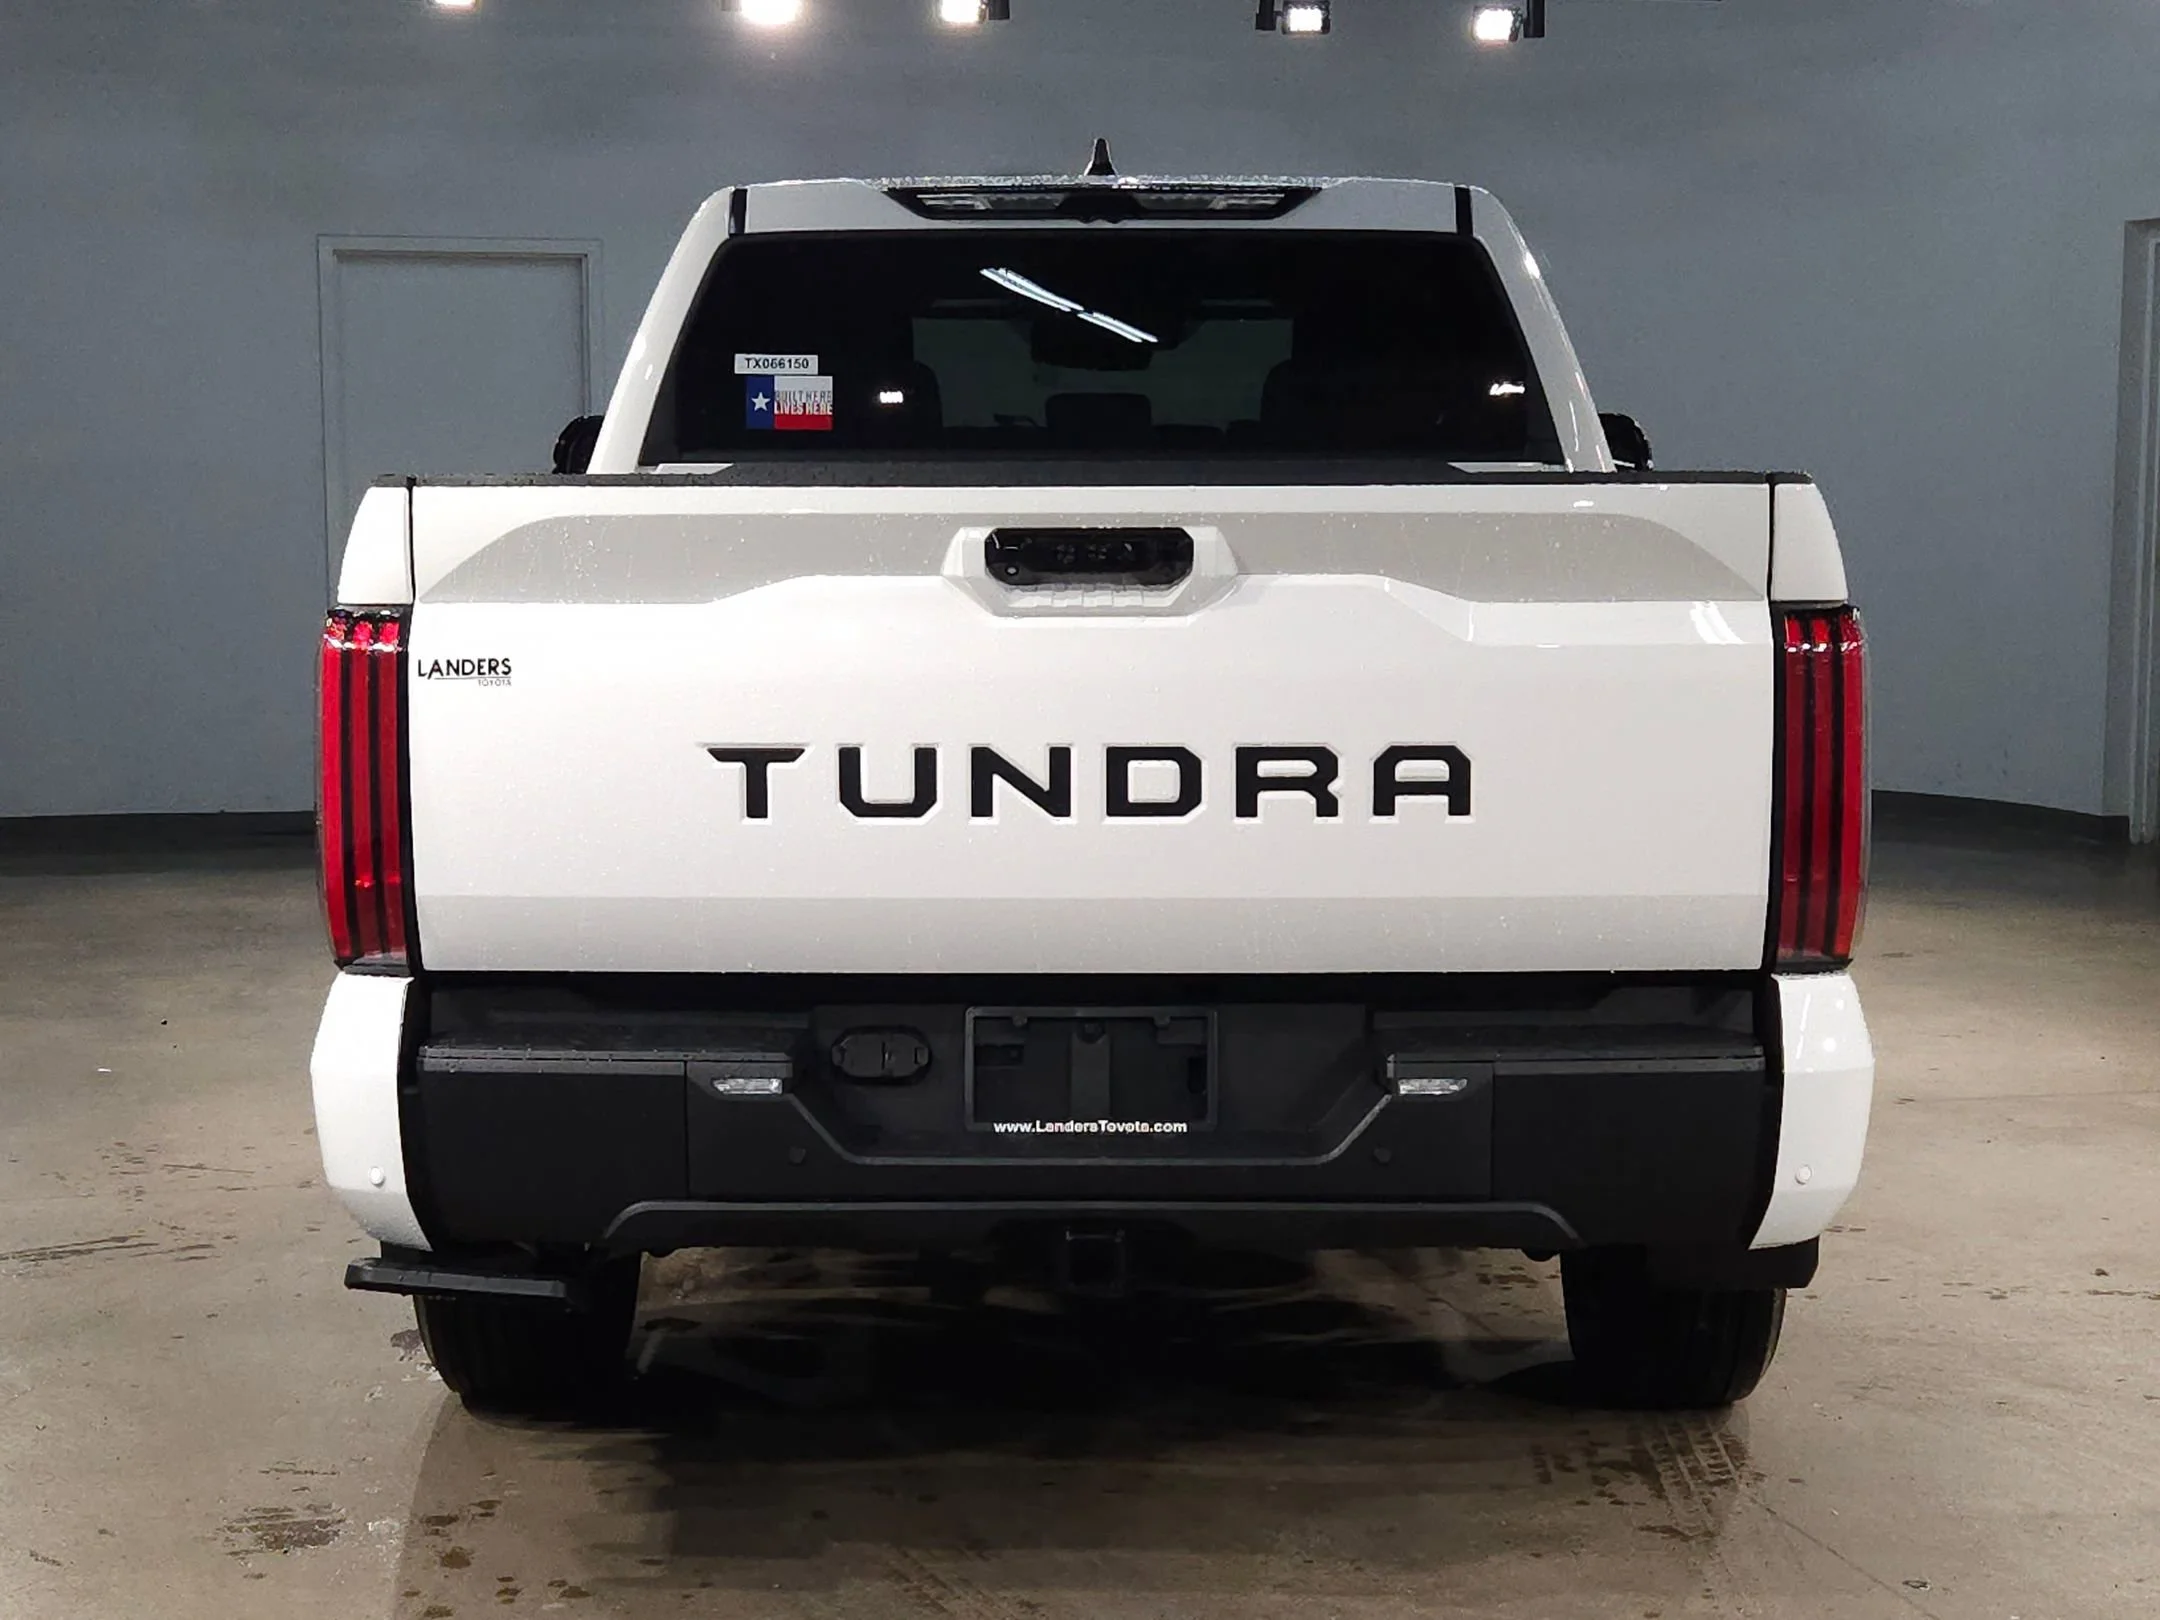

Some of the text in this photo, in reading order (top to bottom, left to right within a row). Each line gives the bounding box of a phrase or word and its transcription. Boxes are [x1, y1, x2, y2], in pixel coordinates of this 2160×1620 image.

[805, 403, 833, 415] HERE
[418, 658, 512, 680] LANDERS
[478, 679, 512, 687] TOYOTA
[706, 745, 1472, 818] TUNDRA
[993, 1120, 1187, 1134] www.LandersToyota.com
